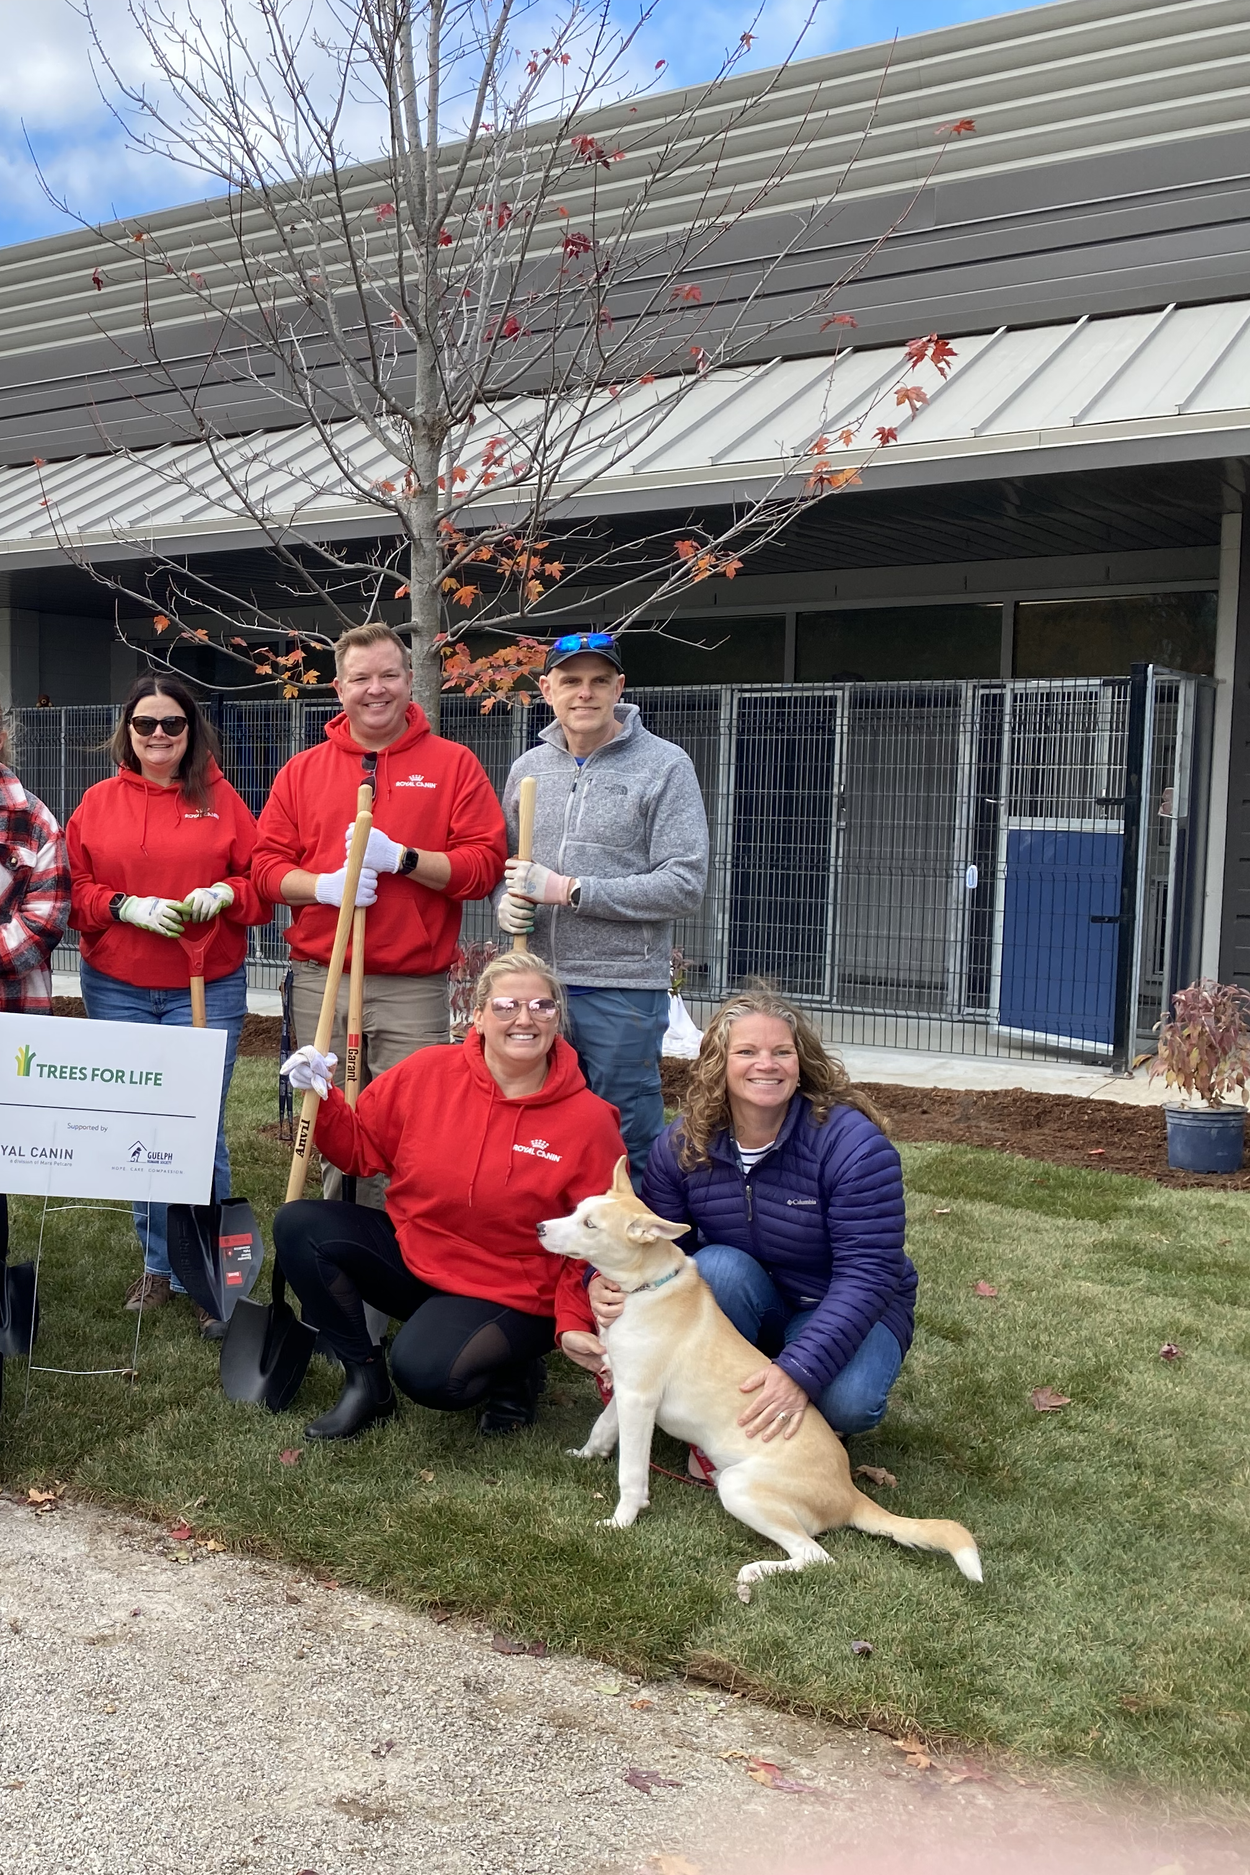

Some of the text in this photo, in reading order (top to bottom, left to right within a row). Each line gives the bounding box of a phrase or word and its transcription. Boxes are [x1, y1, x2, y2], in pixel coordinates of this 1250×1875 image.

[347, 1048, 359, 1083] Garant
[36, 1063, 163, 1087] TREES FOR LIFE
[67, 1122, 108, 1133] Supported by
[295, 1119, 311, 1158] Anvil
[30, 1146, 74, 1160] CANIN
[147, 1151, 173, 1161] GUELPH
[513, 1144, 561, 1162] ROYAL CANIN
